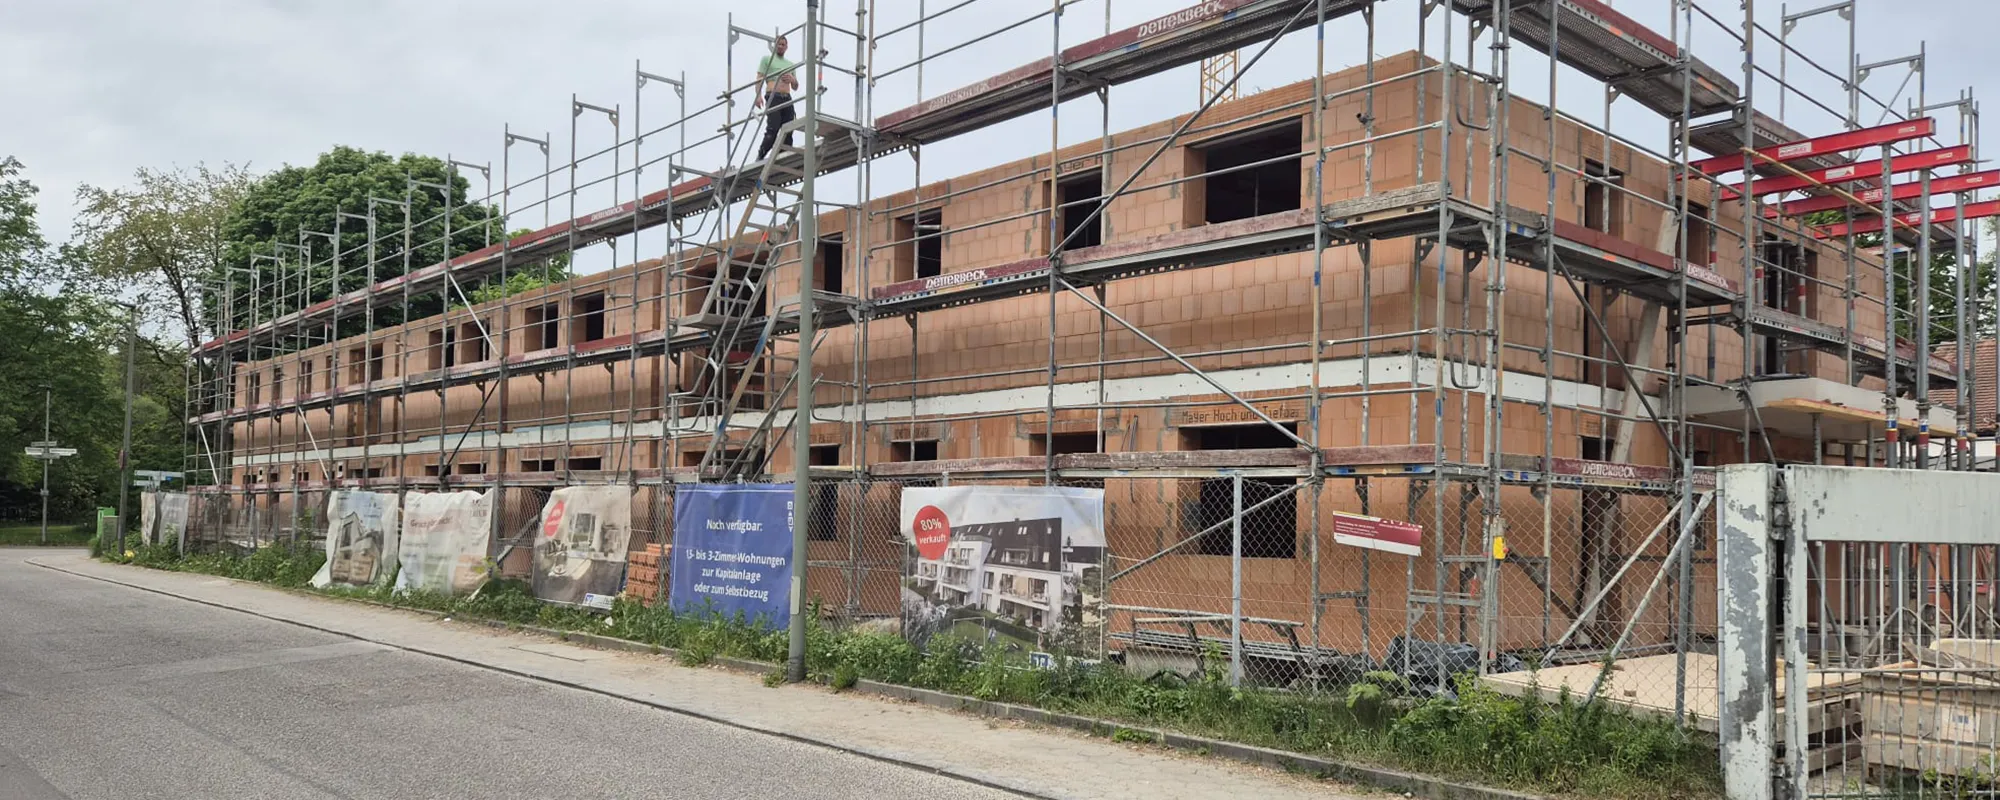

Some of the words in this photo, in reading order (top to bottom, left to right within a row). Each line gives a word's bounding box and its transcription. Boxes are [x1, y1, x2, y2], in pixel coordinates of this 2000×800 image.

[1182, 410, 1210, 423] Mayer
[1213, 408, 1237, 421] Hoch
[706, 519, 725, 530] Noch
[920, 517, 942, 531] 80%
[919, 533, 946, 545] verkauft
[695, 549, 706, 560] bis
[702, 568, 714, 578] zur
[694, 582, 710, 593] oder
[711, 585, 725, 595] zum
[725, 584, 768, 602] Selbstbezug
